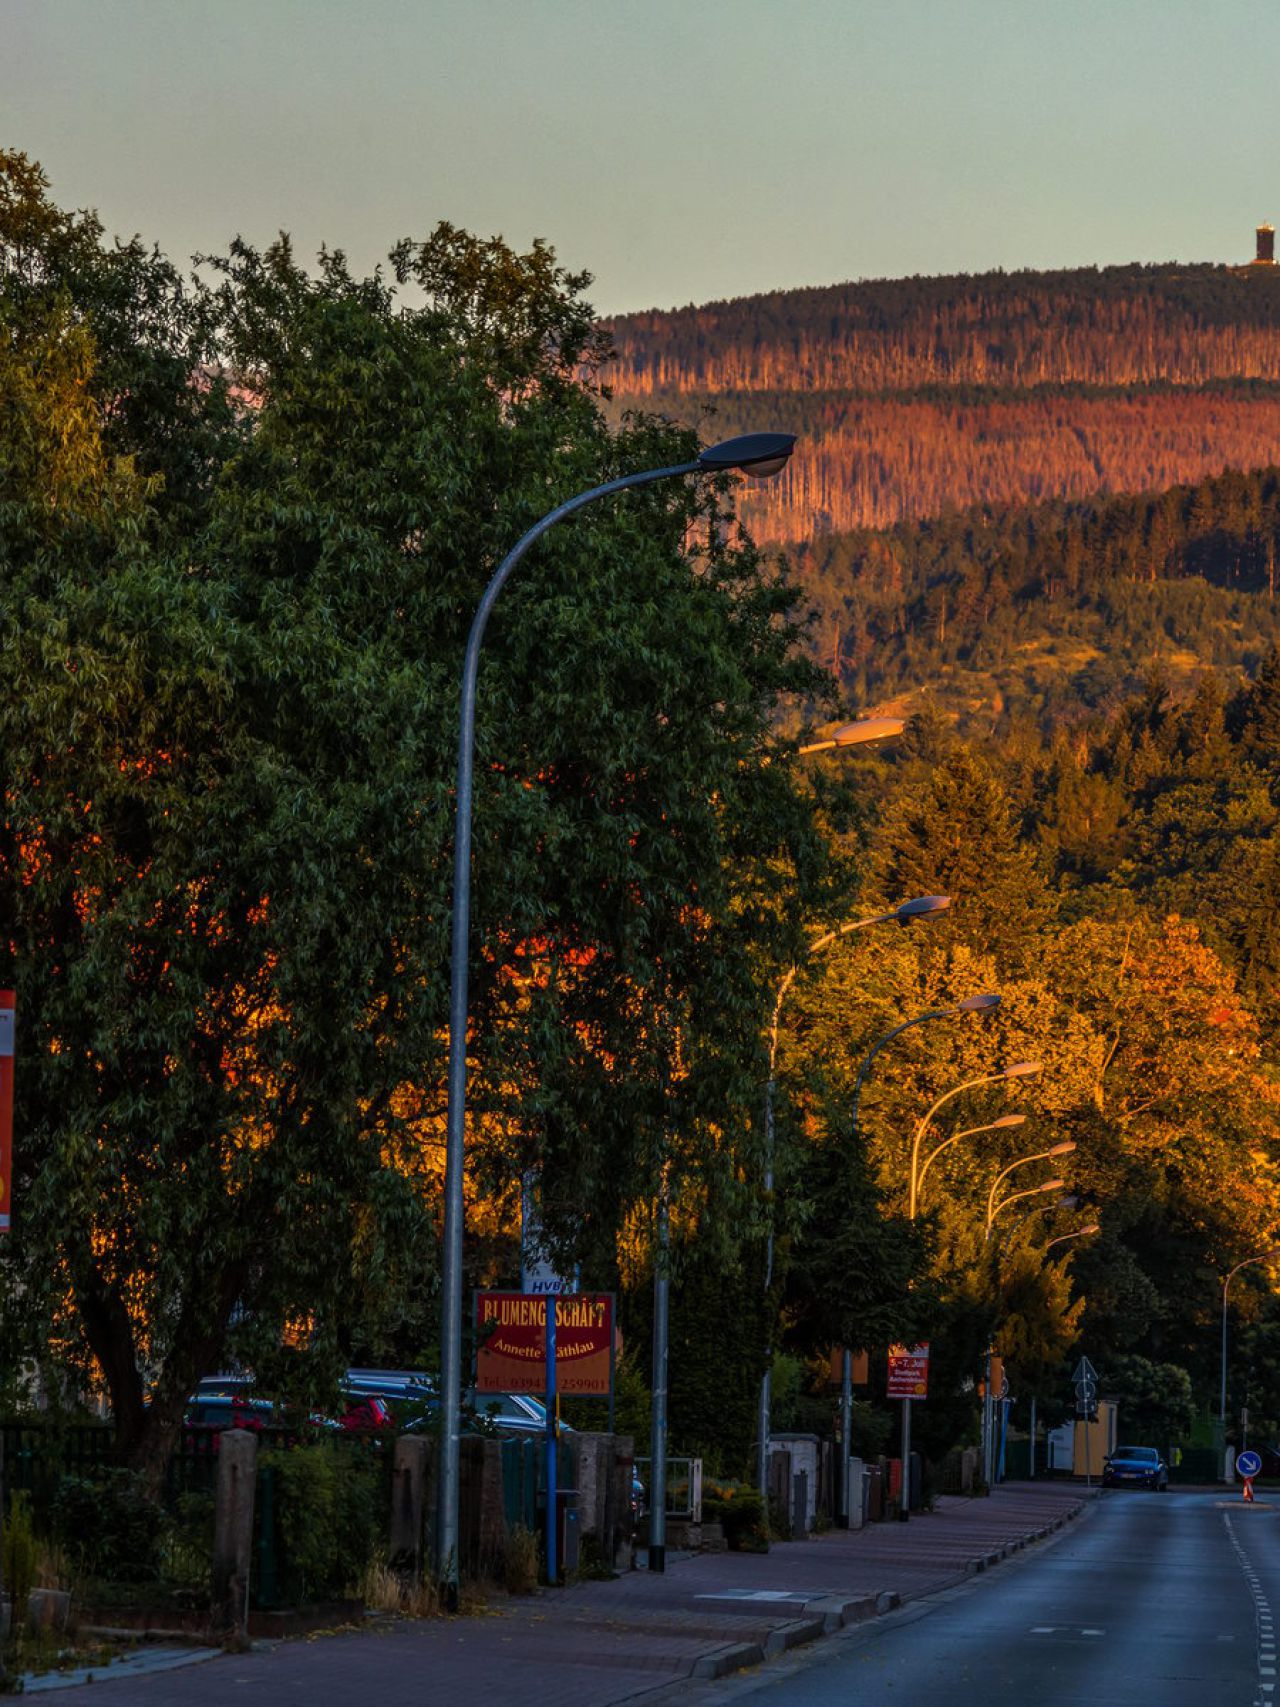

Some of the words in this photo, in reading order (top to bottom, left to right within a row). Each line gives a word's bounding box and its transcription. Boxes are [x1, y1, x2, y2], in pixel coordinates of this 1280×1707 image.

[484, 1297, 606, 1328] BLUMENGSCHÄFT
[494, 1338, 541, 1358] Annette
[546, 1341, 594, 1358] äthlau
[510, 1377, 547, 1390] 0394
